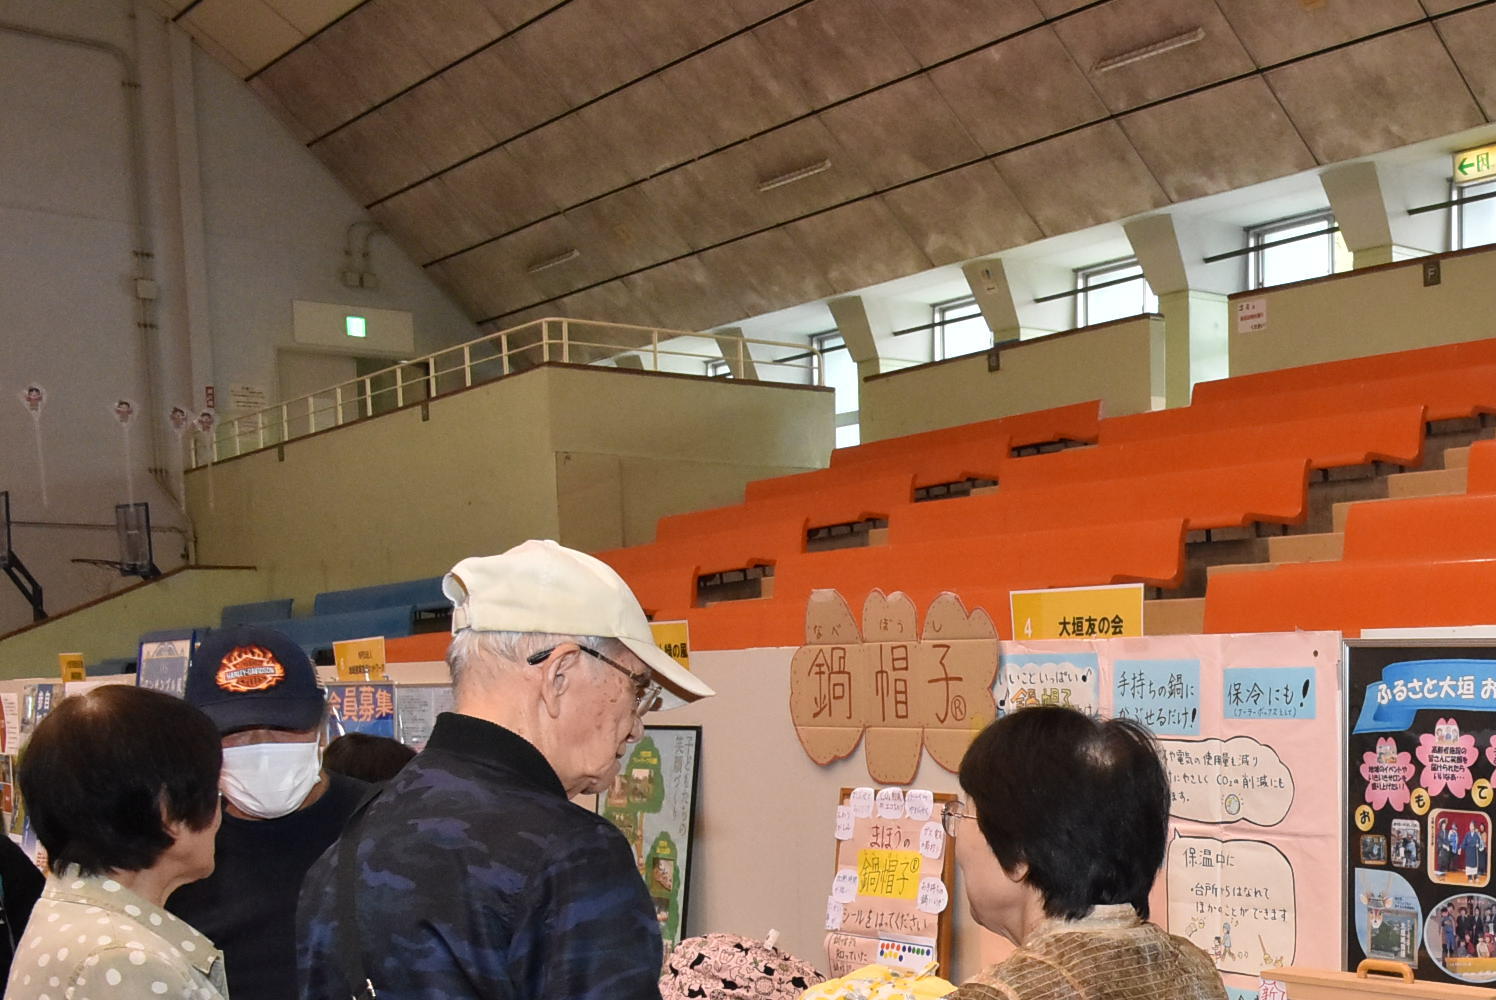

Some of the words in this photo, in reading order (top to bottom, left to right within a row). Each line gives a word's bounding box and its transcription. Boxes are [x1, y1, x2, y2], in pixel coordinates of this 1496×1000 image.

[1023, 617, 1033, 637] 4
[1058, 614, 1125, 637] 大垣友の会
[1117, 672, 1195, 700] 手持ちの鍋に
[1377, 675, 1475, 705] ふるさと大垣
[328, 686, 394, 722] 会員募集
[869, 824, 911, 849] まほうの
[1183, 847, 1236, 868] 保温中に
[842, 907, 928, 932] シールをはってください
